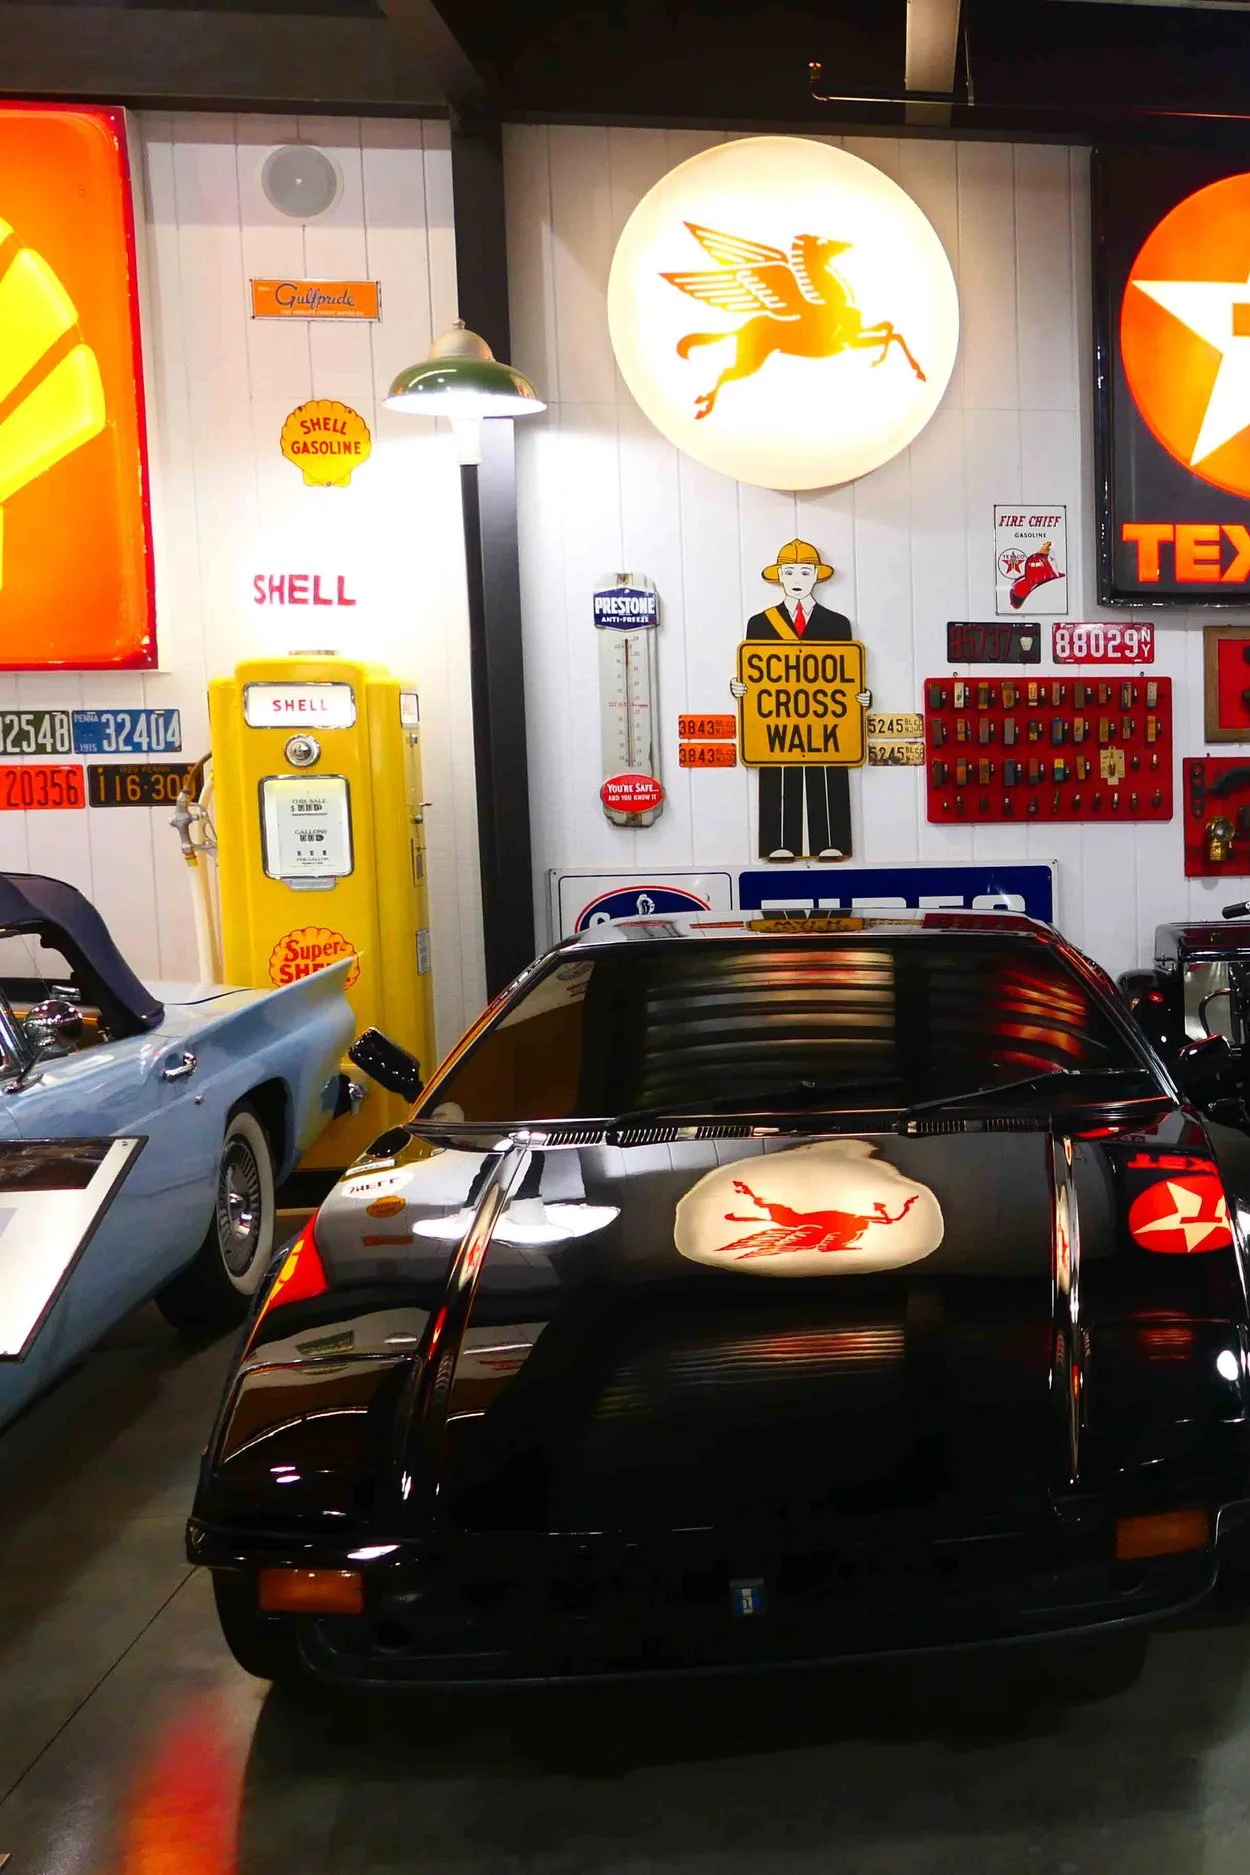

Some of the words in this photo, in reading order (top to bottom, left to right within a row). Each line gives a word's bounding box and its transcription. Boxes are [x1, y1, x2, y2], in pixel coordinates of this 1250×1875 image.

[275, 282, 355, 309] Gulfpride
[300, 417, 347, 436] SHELL
[291, 440, 361, 455] GASOLINE
[998, 515, 1026, 527] FIRE
[1028, 515, 1061, 527] CHIEF
[253, 574, 357, 606] SHELL
[595, 597, 655, 614] PRESTONE
[1055, 629, 1139, 658] 88029
[747, 653, 855, 684] SCHOOL
[272, 699, 328, 711] SHELL
[757, 688, 847, 718] CROSS
[0, 714, 70, 753] 2548
[101, 712, 181, 752] 32404
[679, 720, 714, 735] 3843
[868, 719, 903, 733] 5245
[766, 723, 840, 753] WALK
[679, 748, 715, 763] 3843
[869, 747, 905, 761] 5245
[4, 769, 79, 807] 20356
[607, 784, 634, 793] YOU'RE
